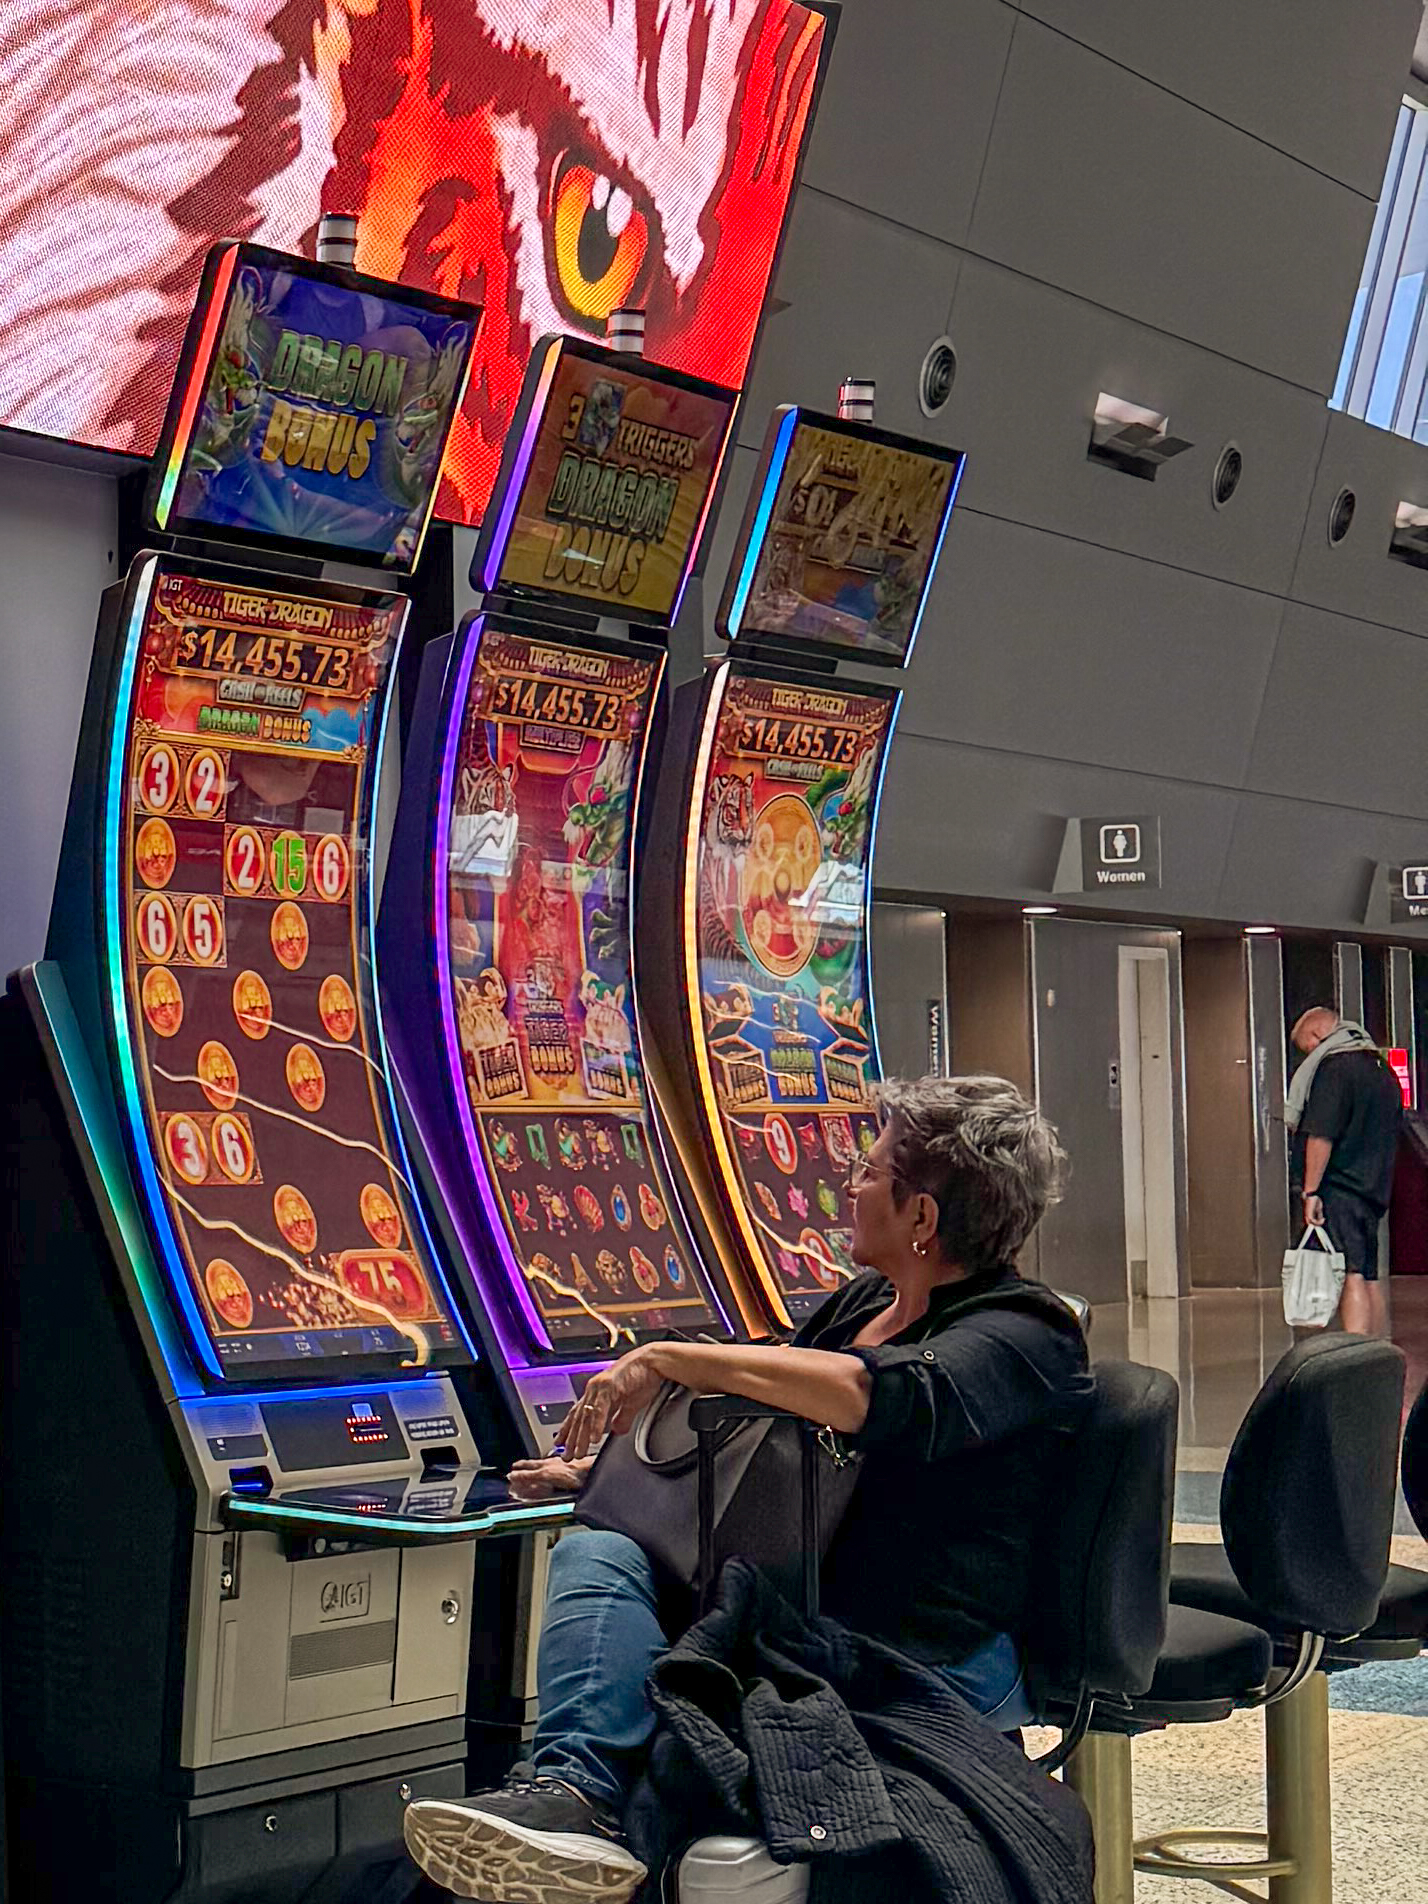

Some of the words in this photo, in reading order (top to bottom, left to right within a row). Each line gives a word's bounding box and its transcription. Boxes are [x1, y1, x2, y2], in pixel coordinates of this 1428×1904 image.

[271, 329, 408, 417] DRAGON
[261, 399, 376, 479] BONUS
[562, 395, 585, 440] 3
[617, 418, 698, 468] TRIGGERS
[548, 450, 680, 543] DRAGON
[545, 522, 646, 595] BONUS
[181, 628, 349, 687] $14,455.73
[495, 680, 620, 731] $14,455.73
[741, 718, 858, 763] $14,455.73
[150, 751, 170, 807] 3
[196, 757, 214, 812] 2
[238, 834, 256, 889] 2
[272, 837, 308, 893] 15
[323, 843, 339, 894] 6
[1096, 870, 1146, 883] Women
[147, 899, 167, 954] 6
[193, 903, 213, 959] 5
[1408, 904, 1428, 917] Me
[176, 1121, 200, 1178] 3
[220, 1119, 245, 1177] 6
[771, 1119, 791, 1165] 9
